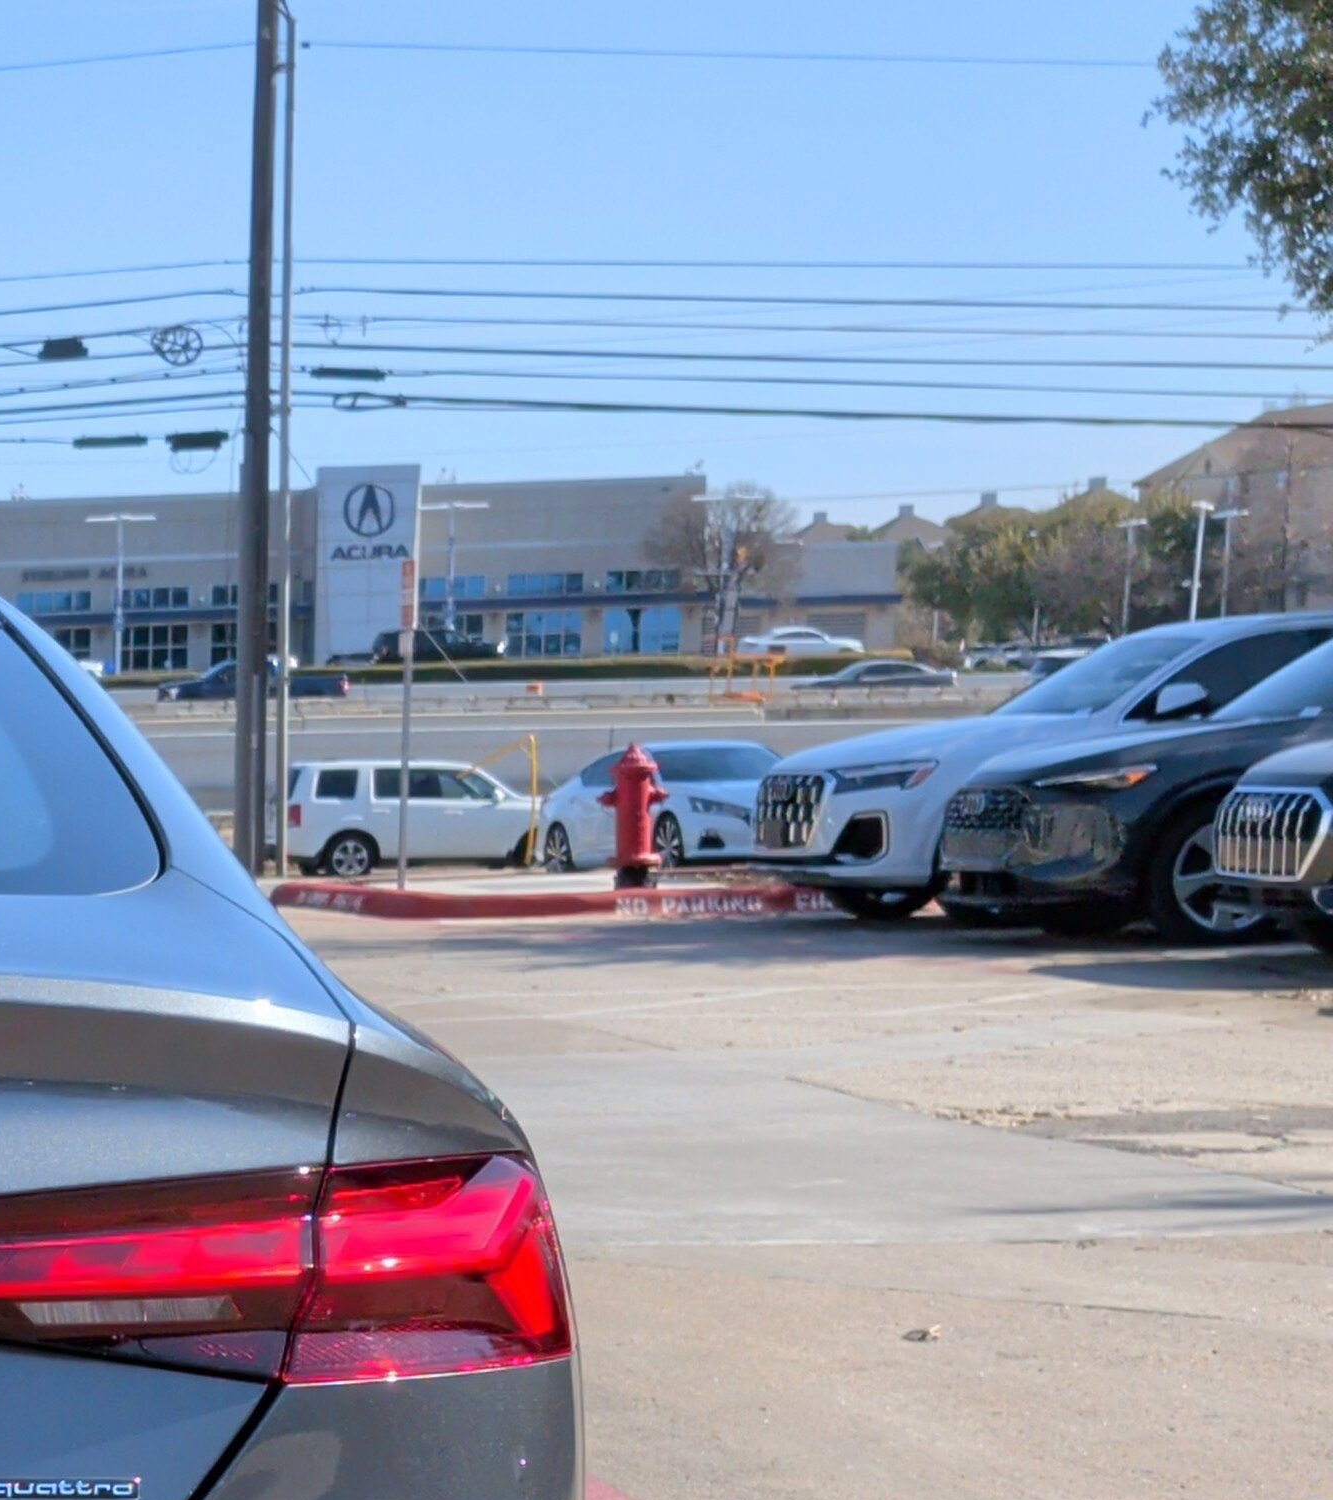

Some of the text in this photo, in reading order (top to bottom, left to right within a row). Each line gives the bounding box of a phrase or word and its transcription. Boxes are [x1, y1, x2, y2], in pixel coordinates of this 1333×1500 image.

[331, 544, 409, 560] ACURA
[615, 896, 648, 916] NO
[661, 894, 764, 914] PARKING
